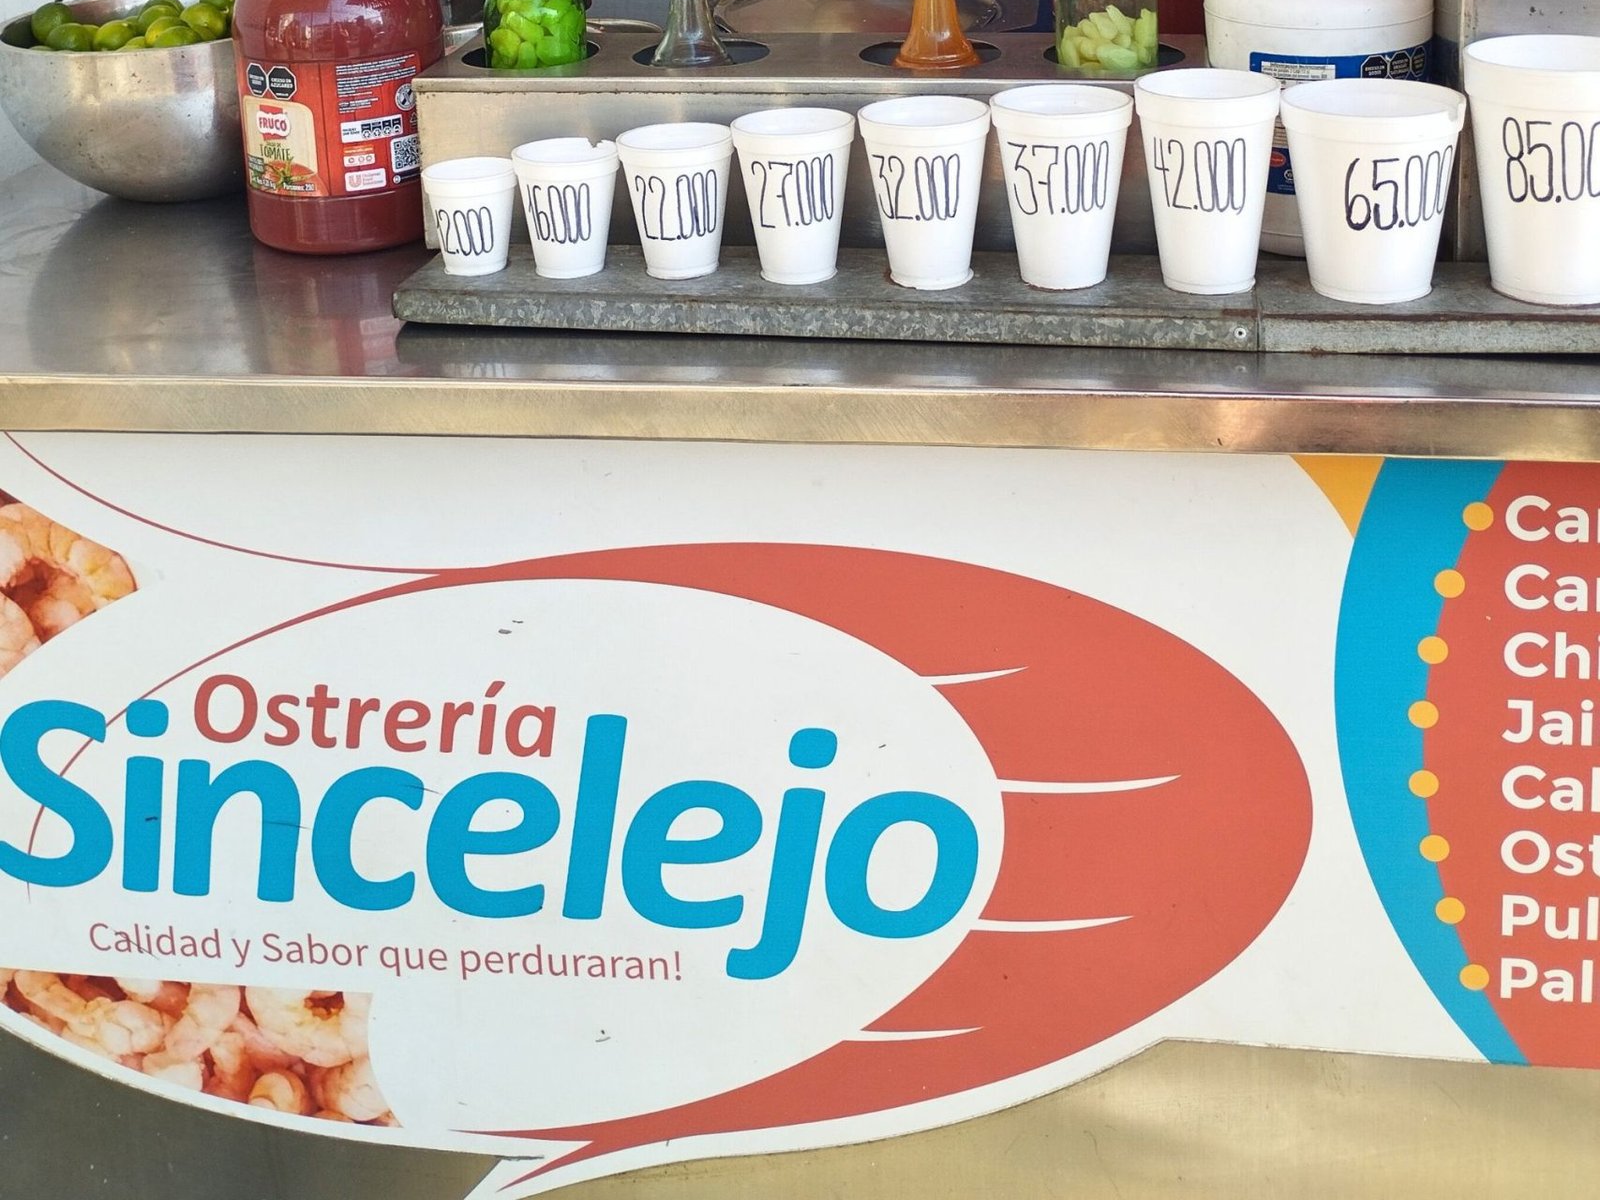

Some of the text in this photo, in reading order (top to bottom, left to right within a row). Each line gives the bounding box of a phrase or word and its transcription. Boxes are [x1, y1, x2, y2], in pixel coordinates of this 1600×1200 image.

[258, 117, 287, 132] FRUCO
[635, 169, 718, 241] 22.000
[751, 153, 834, 228] 27.000
[872, 153, 961, 221] 32.000
[1007, 140, 1109, 215] 37.000
[1154, 137, 1247, 215] 42.000
[1344, 144, 1453, 231] 65.000
[434, 206, 494, 257] 12.000
[526, 182, 592, 244] 16.000
[1505, 494, 1600, 543] Ca
[1504, 563, 1600, 612] Ca
[192, 673, 557, 758] Ostrería
[0, 699, 979, 980] Sincelejo
[89, 922, 683, 982] Calidad y Sabor que perduraran!
